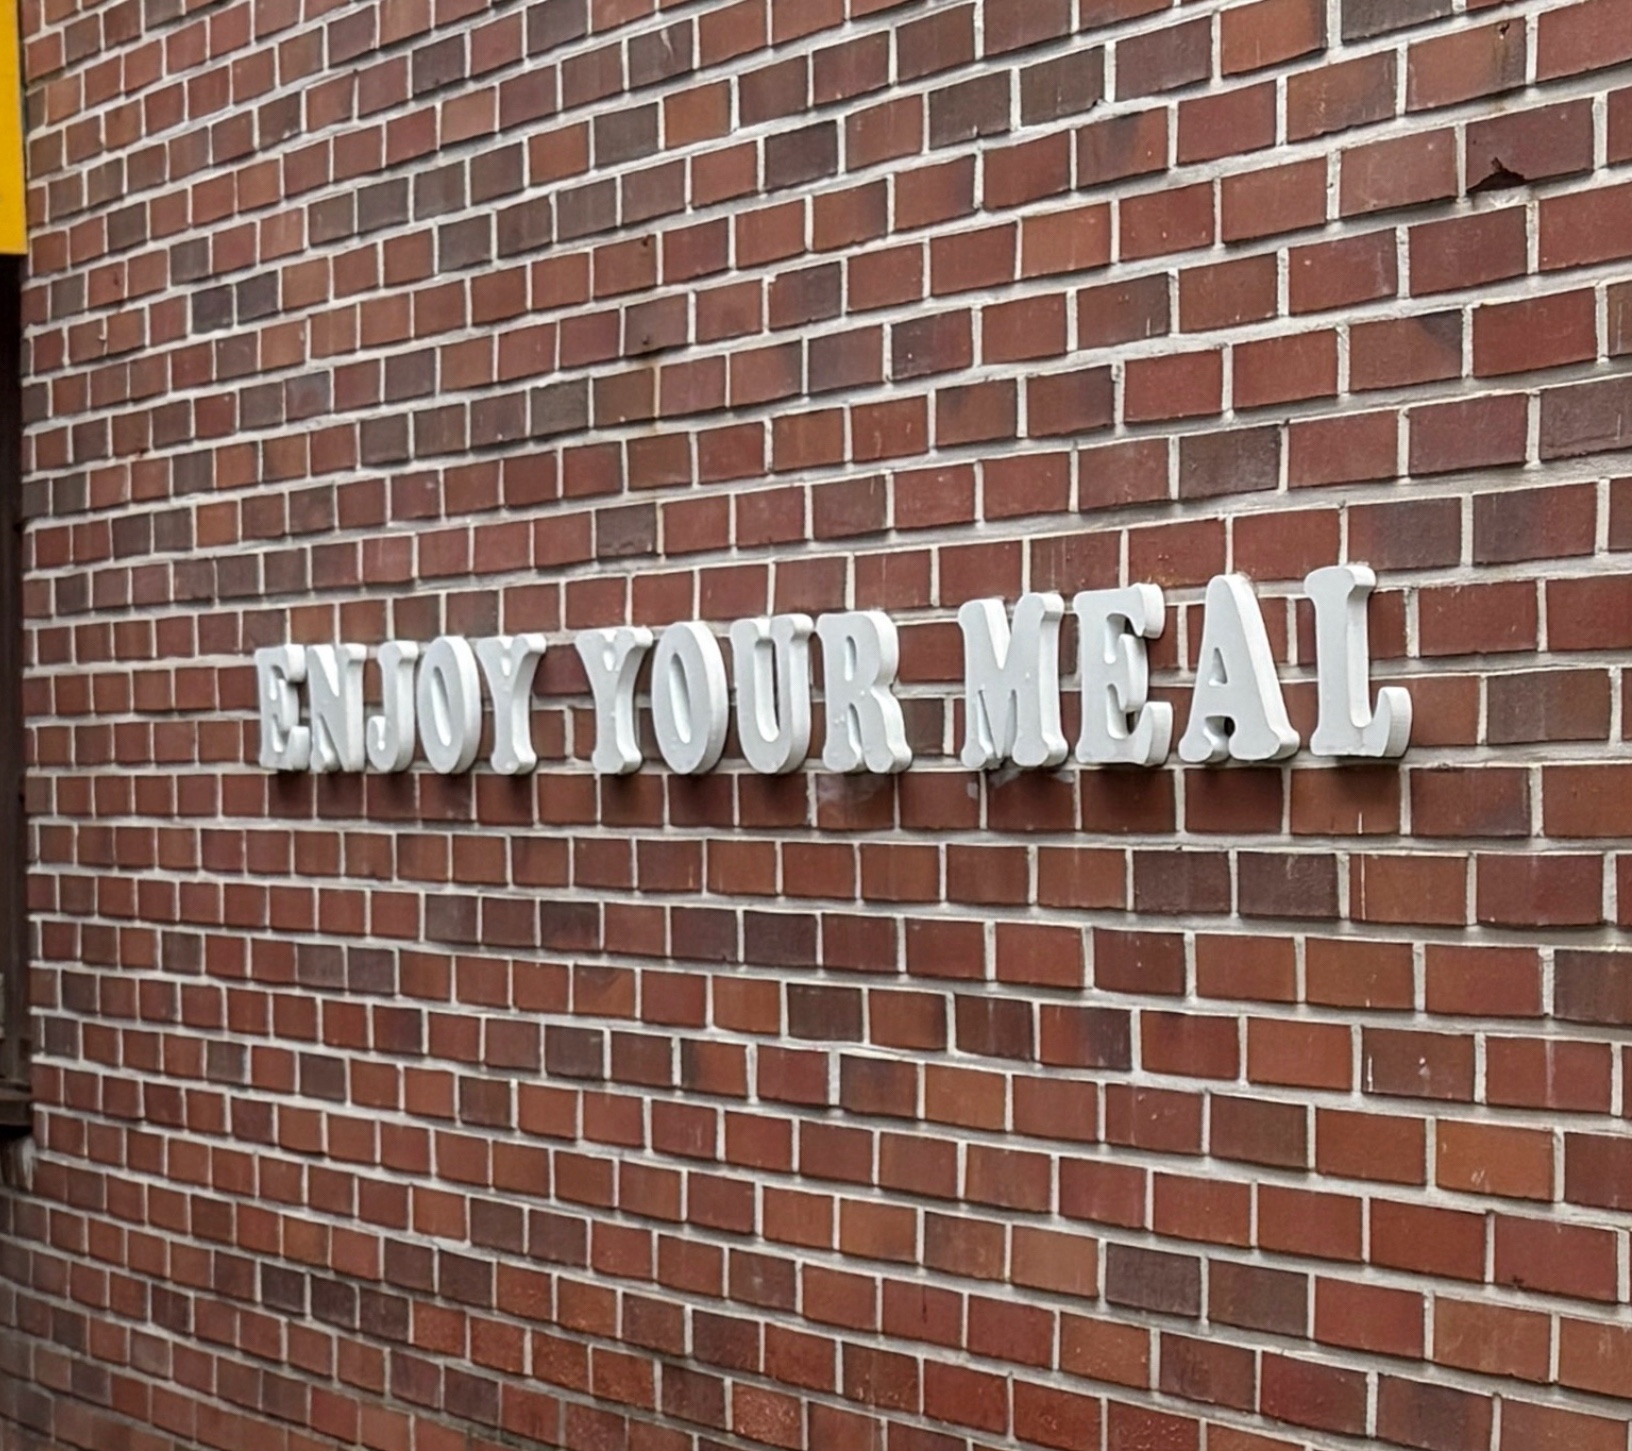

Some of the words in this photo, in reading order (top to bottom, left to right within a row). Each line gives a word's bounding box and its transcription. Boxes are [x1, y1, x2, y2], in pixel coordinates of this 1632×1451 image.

[254, 633, 547, 776] ENJOY
[574, 611, 911, 776] YOUR
[957, 564, 1412, 770] MEAL
